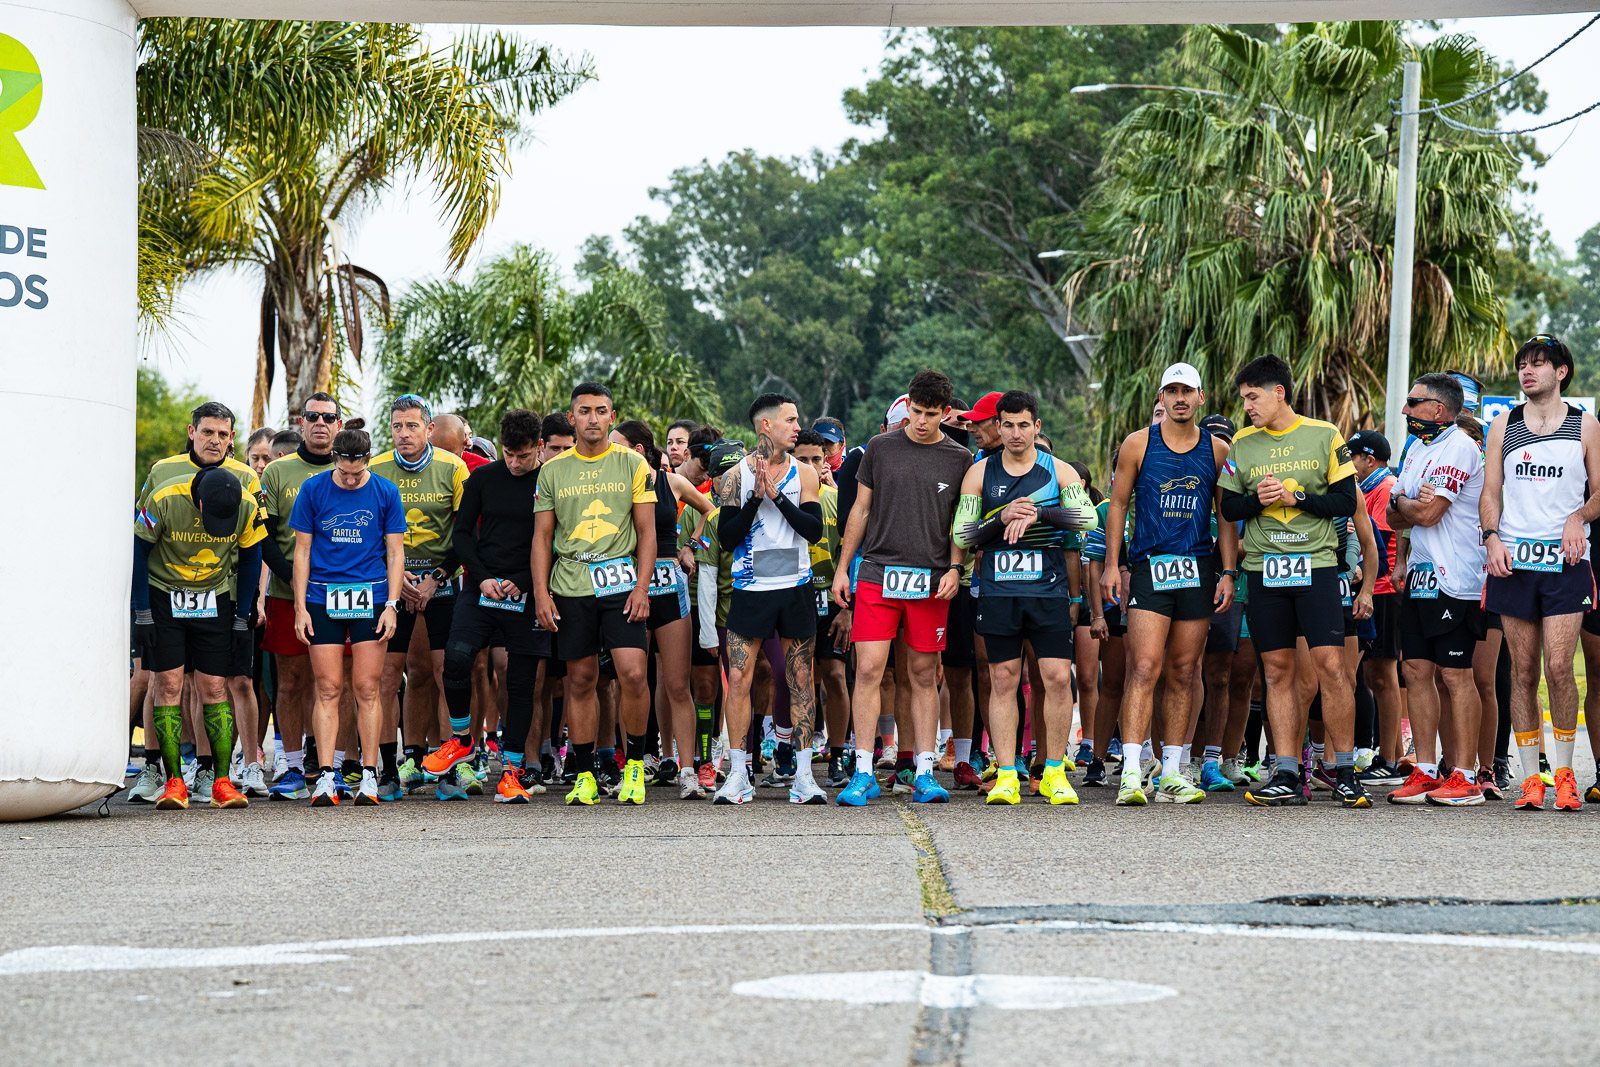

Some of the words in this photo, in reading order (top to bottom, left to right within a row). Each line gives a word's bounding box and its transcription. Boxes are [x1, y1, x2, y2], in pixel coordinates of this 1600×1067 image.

[1250, 459, 1320, 478] ANIVERSARIO
[400, 492, 444, 503] ERSARIO
[558, 481, 626, 500] ANIVERSARIO
[1160, 494, 1199, 510] FARTLEK
[332, 528, 361, 538] FARTLEK
[997, 550, 1036, 574] 021
[1516, 540, 1559, 566] 095
[593, 562, 633, 589] 035
[650, 565, 673, 588] 43
[1154, 557, 1195, 583] 048
[1265, 555, 1308, 580] 034
[1514, 563, 1542, 571] DIAMANTE
[1542, 565, 1561, 573] CORRE
[886, 569, 927, 592] 074
[1156, 582, 1181, 590] DIAMANTE
[1411, 568, 1438, 591] 046
[173, 590, 210, 611] 037
[330, 588, 370, 611] 114
[597, 586, 622, 596] DIAMANTE
[481, 600, 505, 608] DIAMANTE
